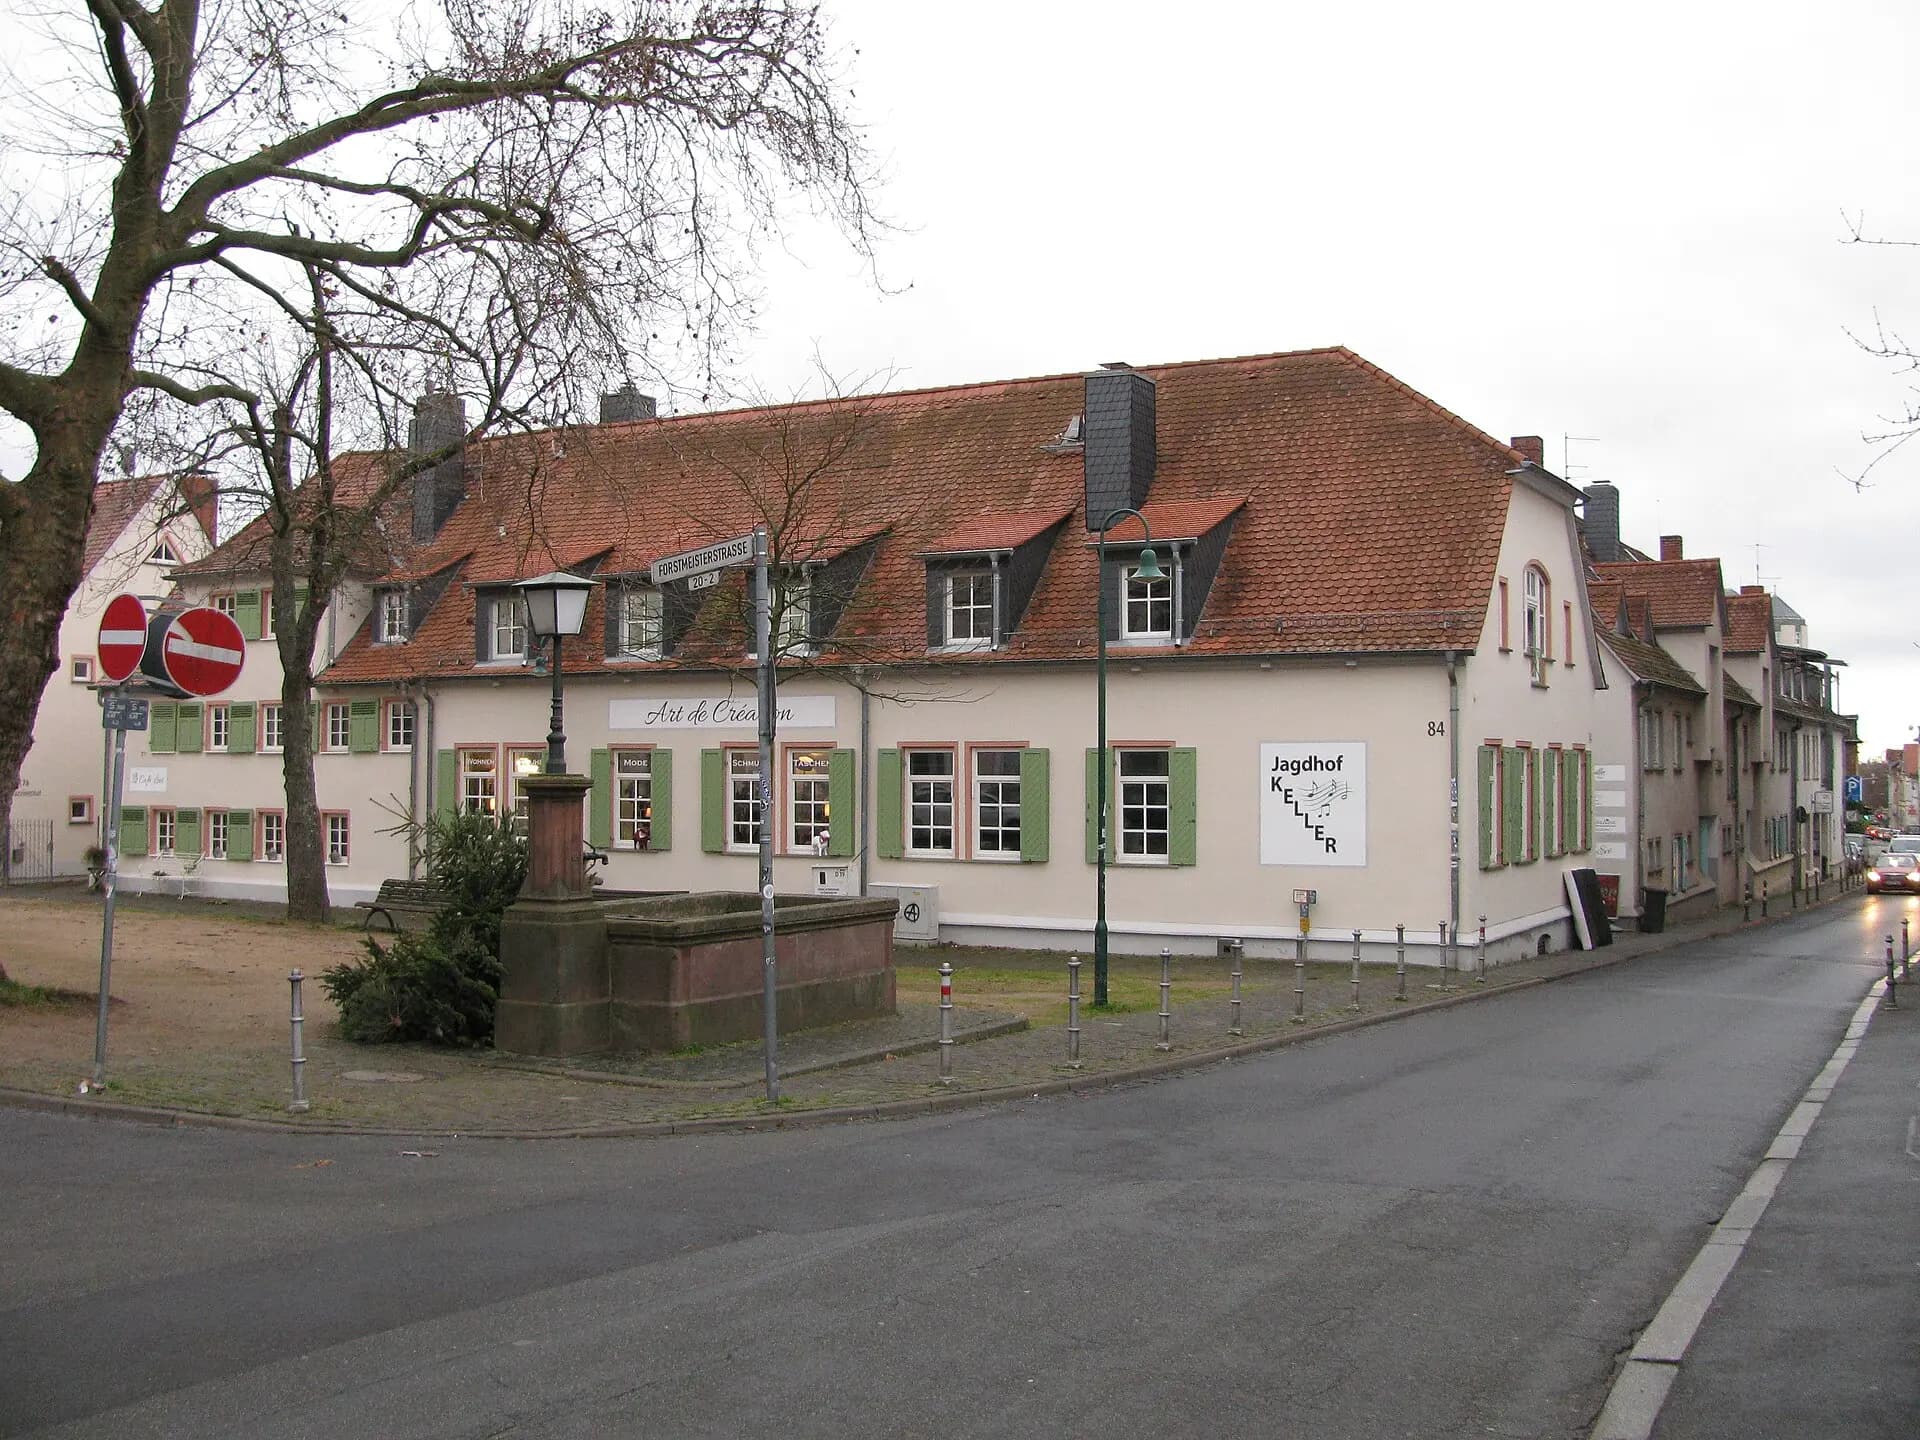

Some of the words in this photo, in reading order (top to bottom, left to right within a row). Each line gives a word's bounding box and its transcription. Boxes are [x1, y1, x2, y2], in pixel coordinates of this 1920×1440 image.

[658, 541, 748, 577] FORSTMEISTERSTRASSE
[693, 577, 703, 588] 20
[709, 573, 715, 584] 2
[645, 701, 683, 725] Art
[688, 700, 709, 725] de
[712, 699, 795, 724] Créaon
[1427, 721, 1445, 736] 84
[732, 759, 760, 767] SCHMU
[1271, 754, 1344, 776] Jagdhof
[1271, 776, 1337, 853] KELLER
